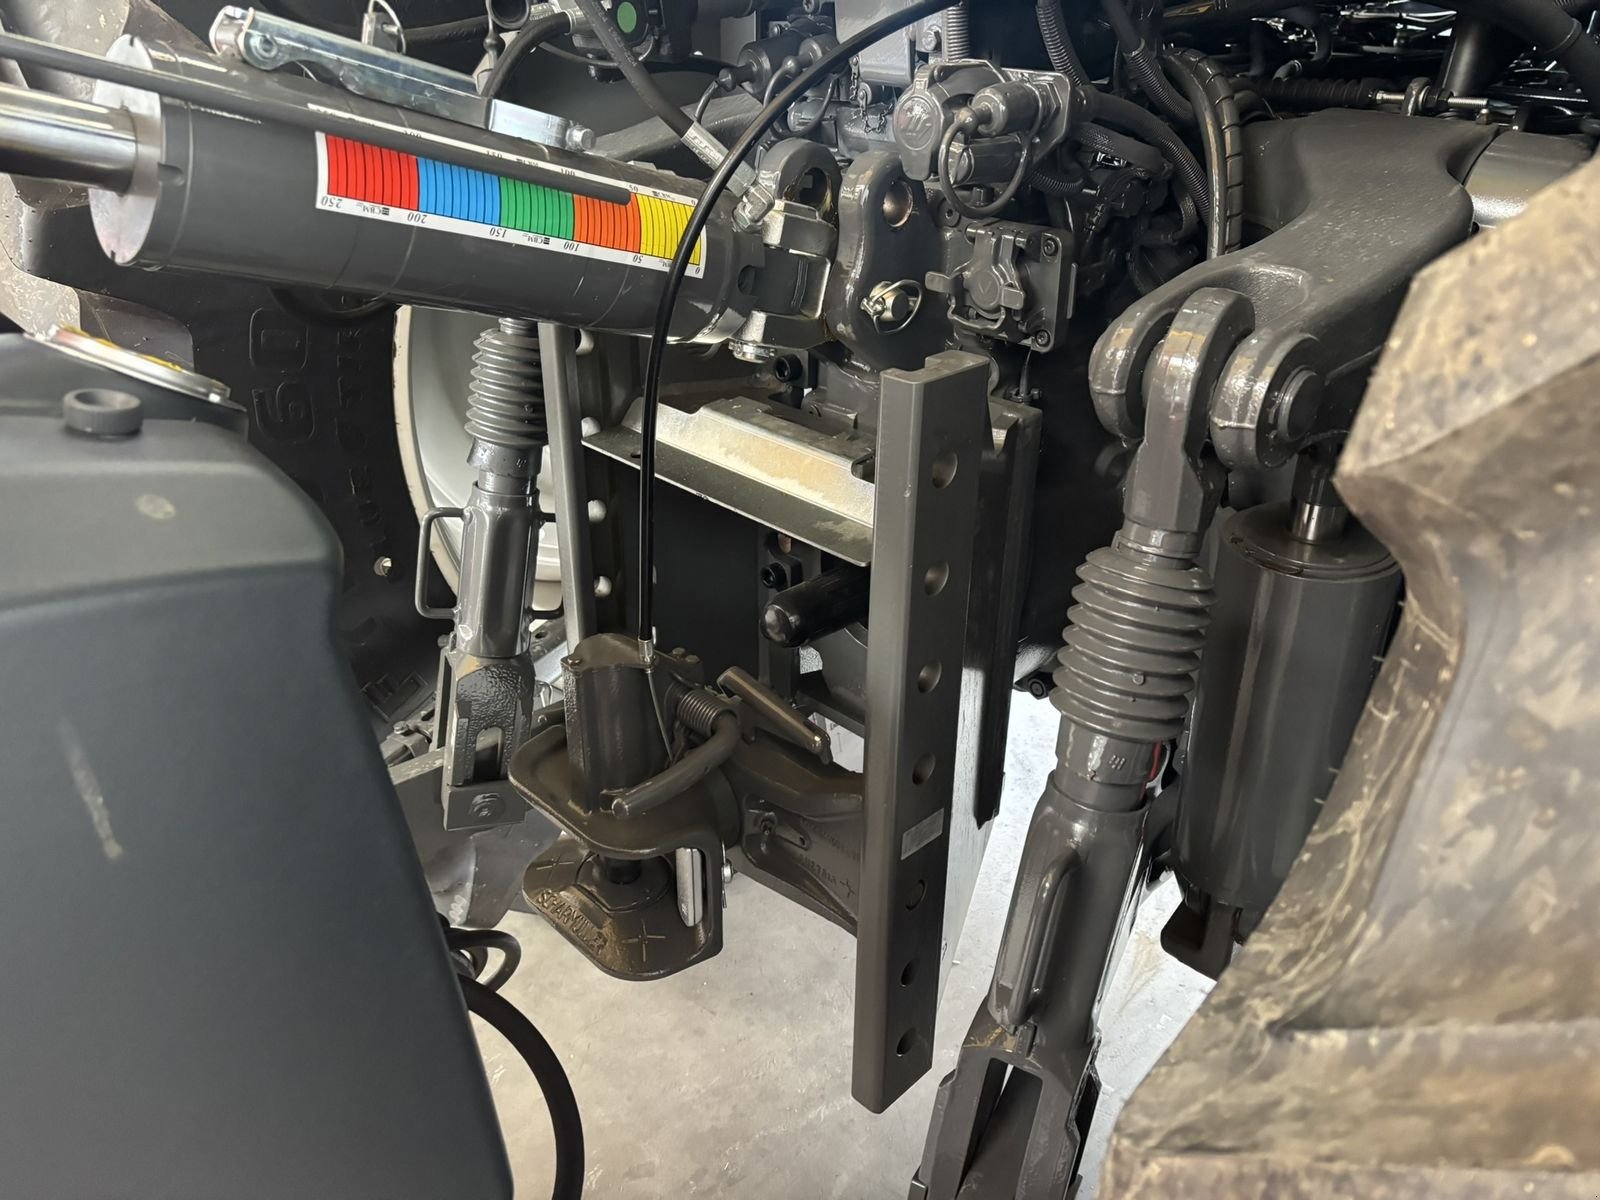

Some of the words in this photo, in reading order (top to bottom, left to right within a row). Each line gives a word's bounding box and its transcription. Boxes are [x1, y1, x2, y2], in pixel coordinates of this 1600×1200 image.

[560, 167, 576, 178] 100
[628, 183, 639, 193] 50
[321, 195, 344, 210] 250
[407, 211, 428, 225] 200
[489, 227, 507, 239] 150
[563, 241, 580, 253] 100
[632, 254, 644, 264] 50
[694, 266, 701, 275] 0
